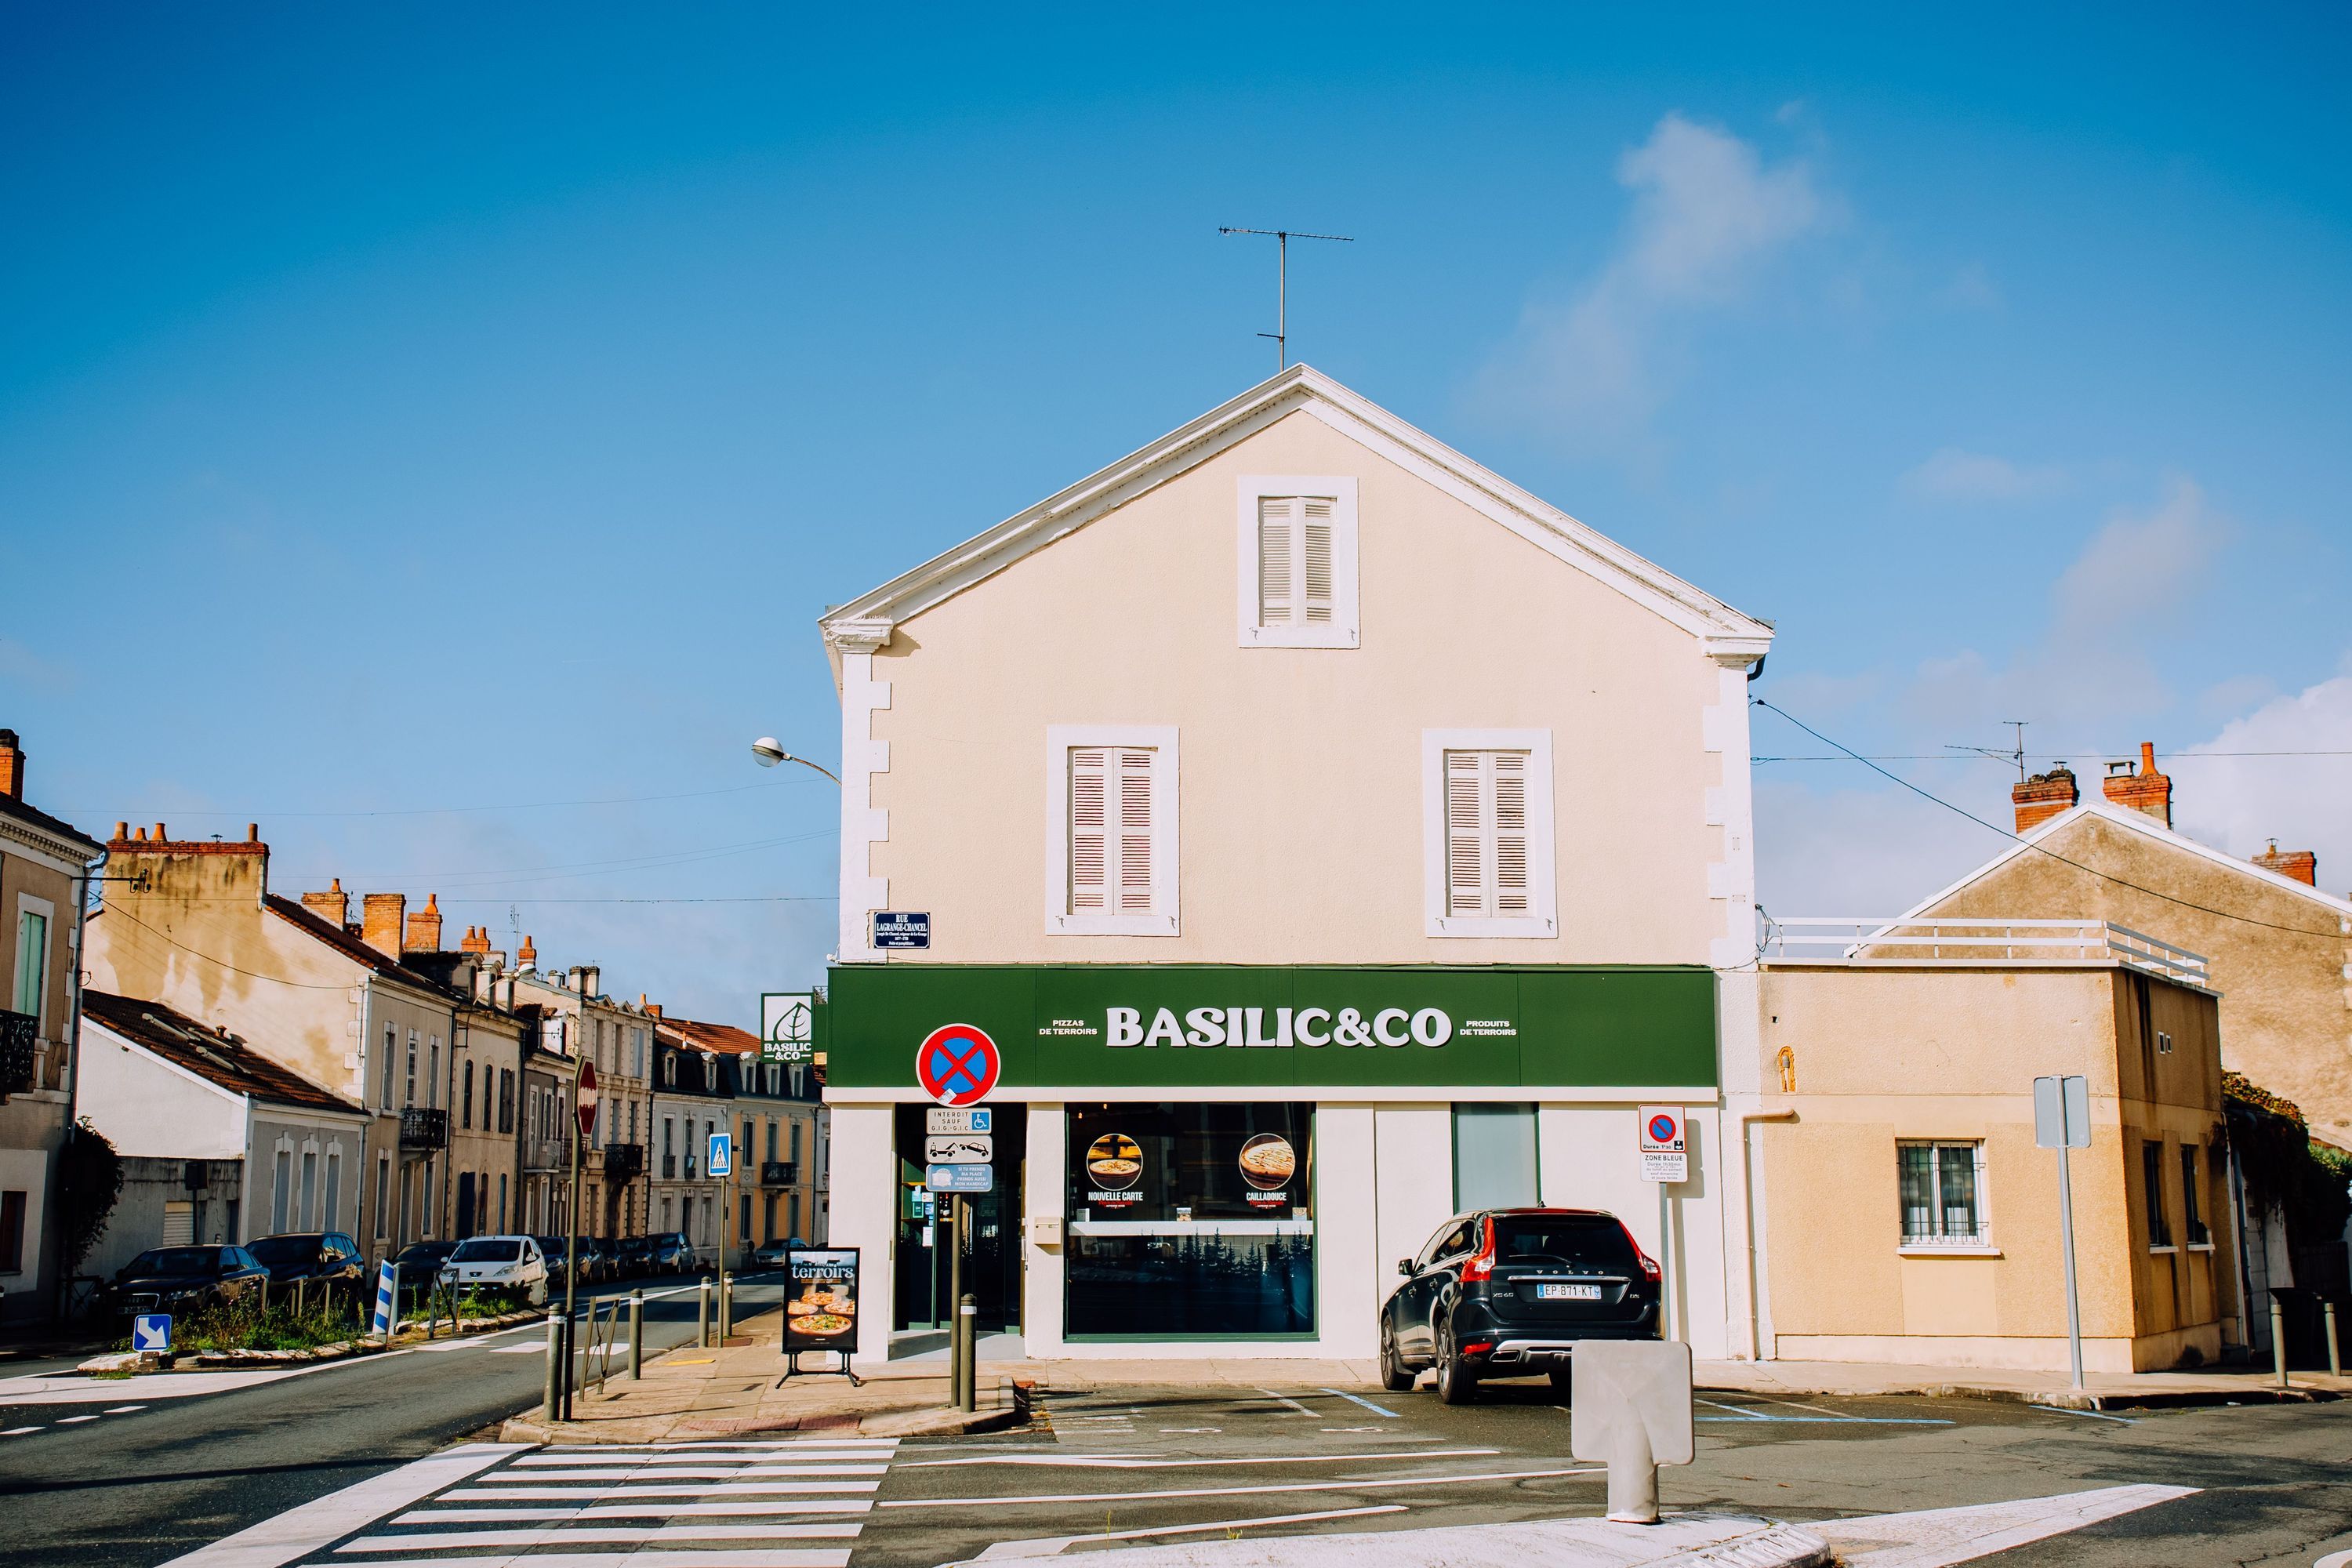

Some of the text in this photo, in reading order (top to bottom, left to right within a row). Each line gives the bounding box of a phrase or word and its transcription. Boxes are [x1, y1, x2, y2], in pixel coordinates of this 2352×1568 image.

[896, 914, 908, 922] RUE
[877, 923, 927, 931] LAGRANGE-CHANCEL
[1105, 1007, 1452, 1047] BASILIC&CO
[764, 1043, 811, 1052] BASILIC
[775, 1052, 800, 1060] &CO
[580, 1086, 596, 1109] STOP
[1088, 1192, 1143, 1201] NOUVELLE CARTE
[1246, 1192, 1287, 1201] CAILLADOUCE
[791, 1264, 854, 1278] terroirs
[1545, 1286, 1593, 1296] EP-871-KT
